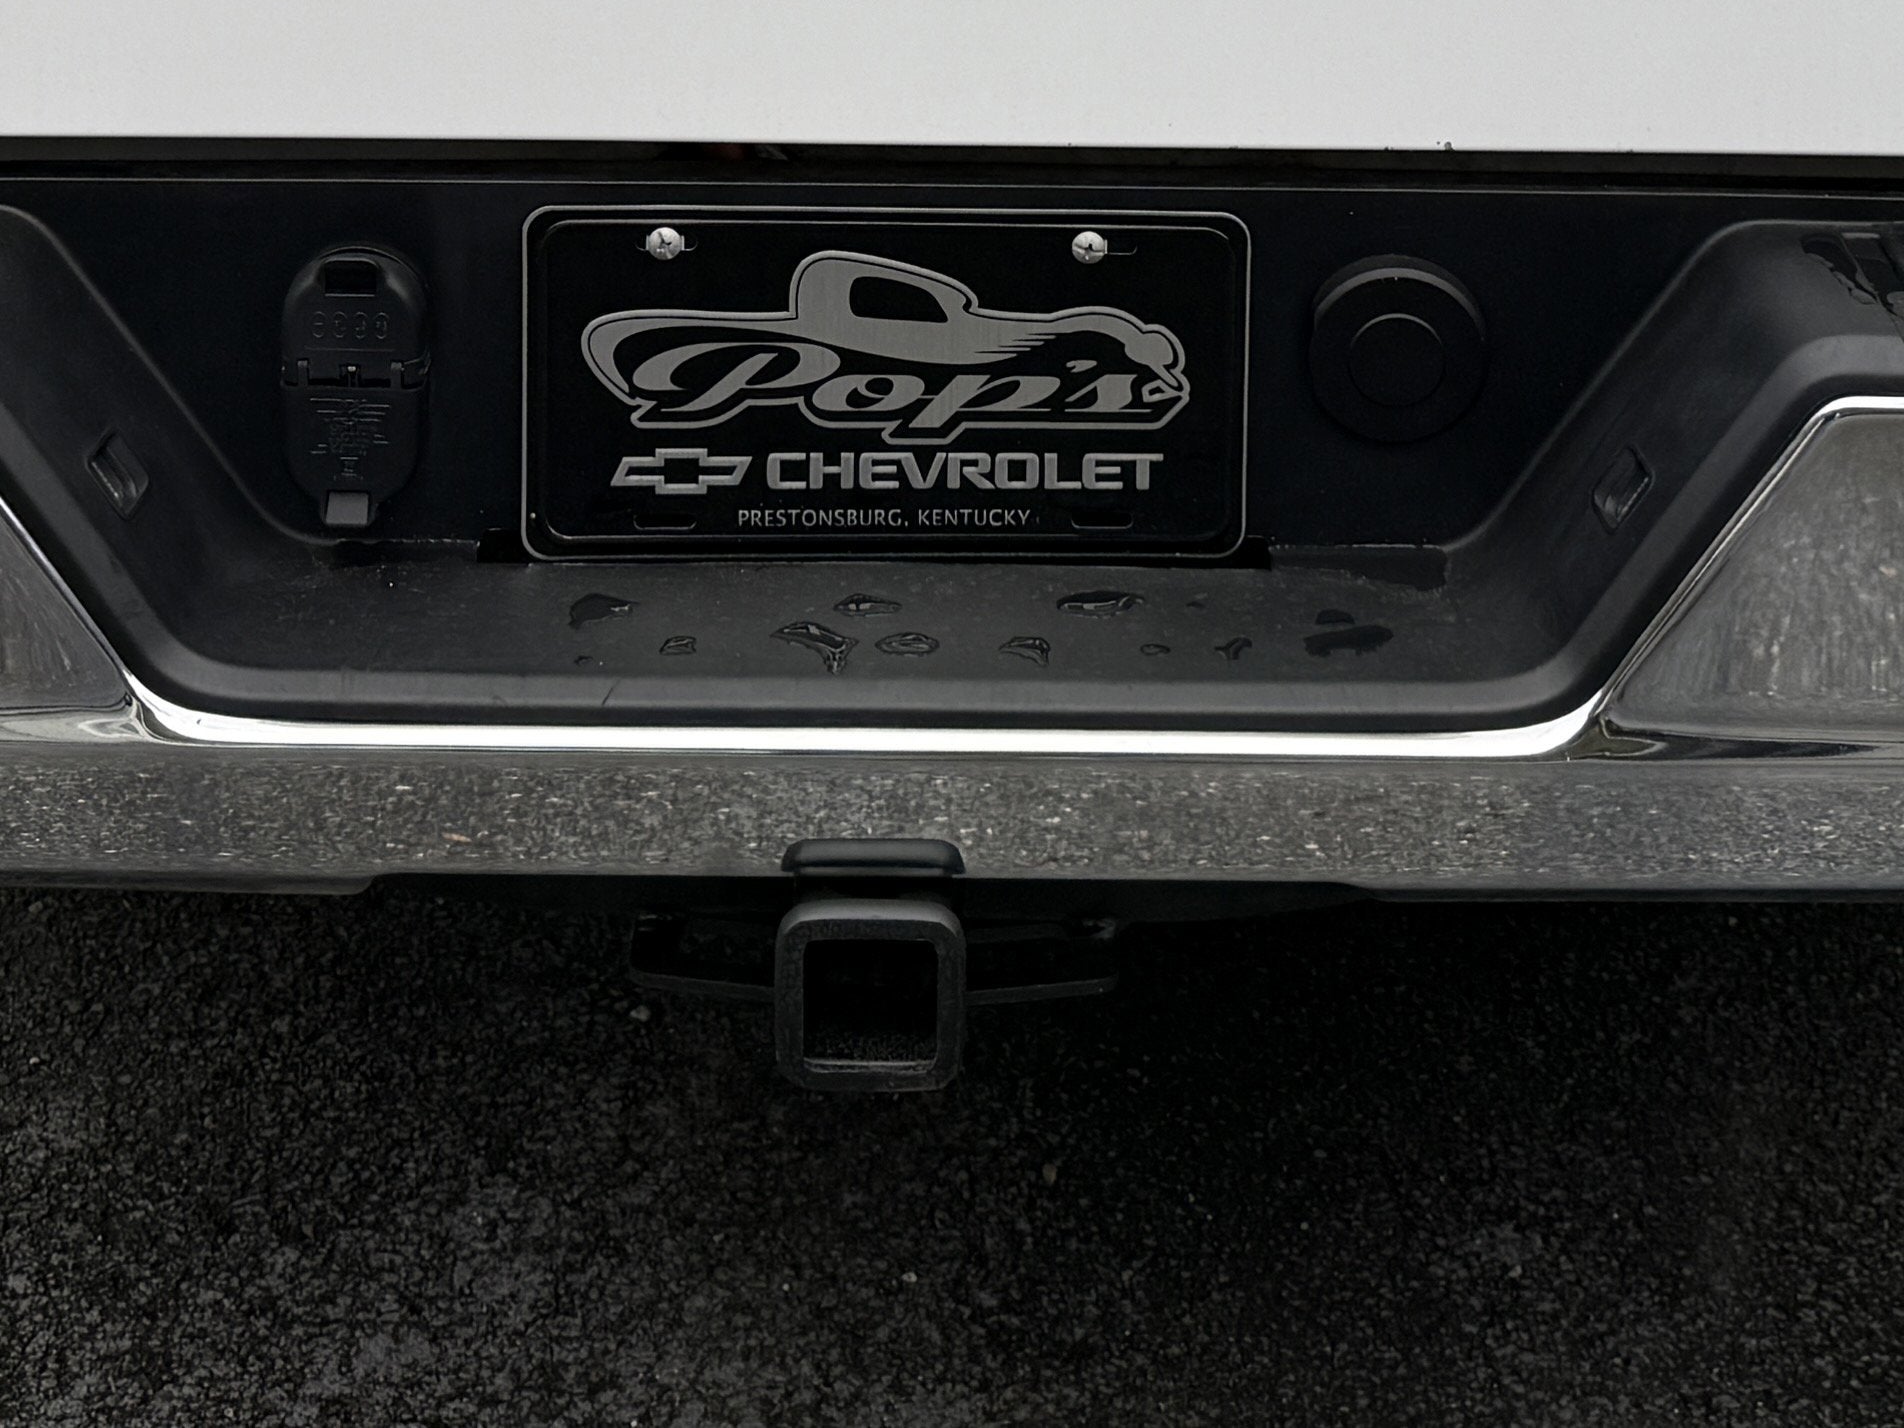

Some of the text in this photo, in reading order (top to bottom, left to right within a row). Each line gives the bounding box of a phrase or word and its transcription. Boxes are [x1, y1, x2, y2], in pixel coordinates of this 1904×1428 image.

[632, 343, 1154, 428] Pop's
[765, 451, 1165, 491] CHEVROLET
[737, 507, 1031, 529] PRESTONSBURG, KENTUCKY
